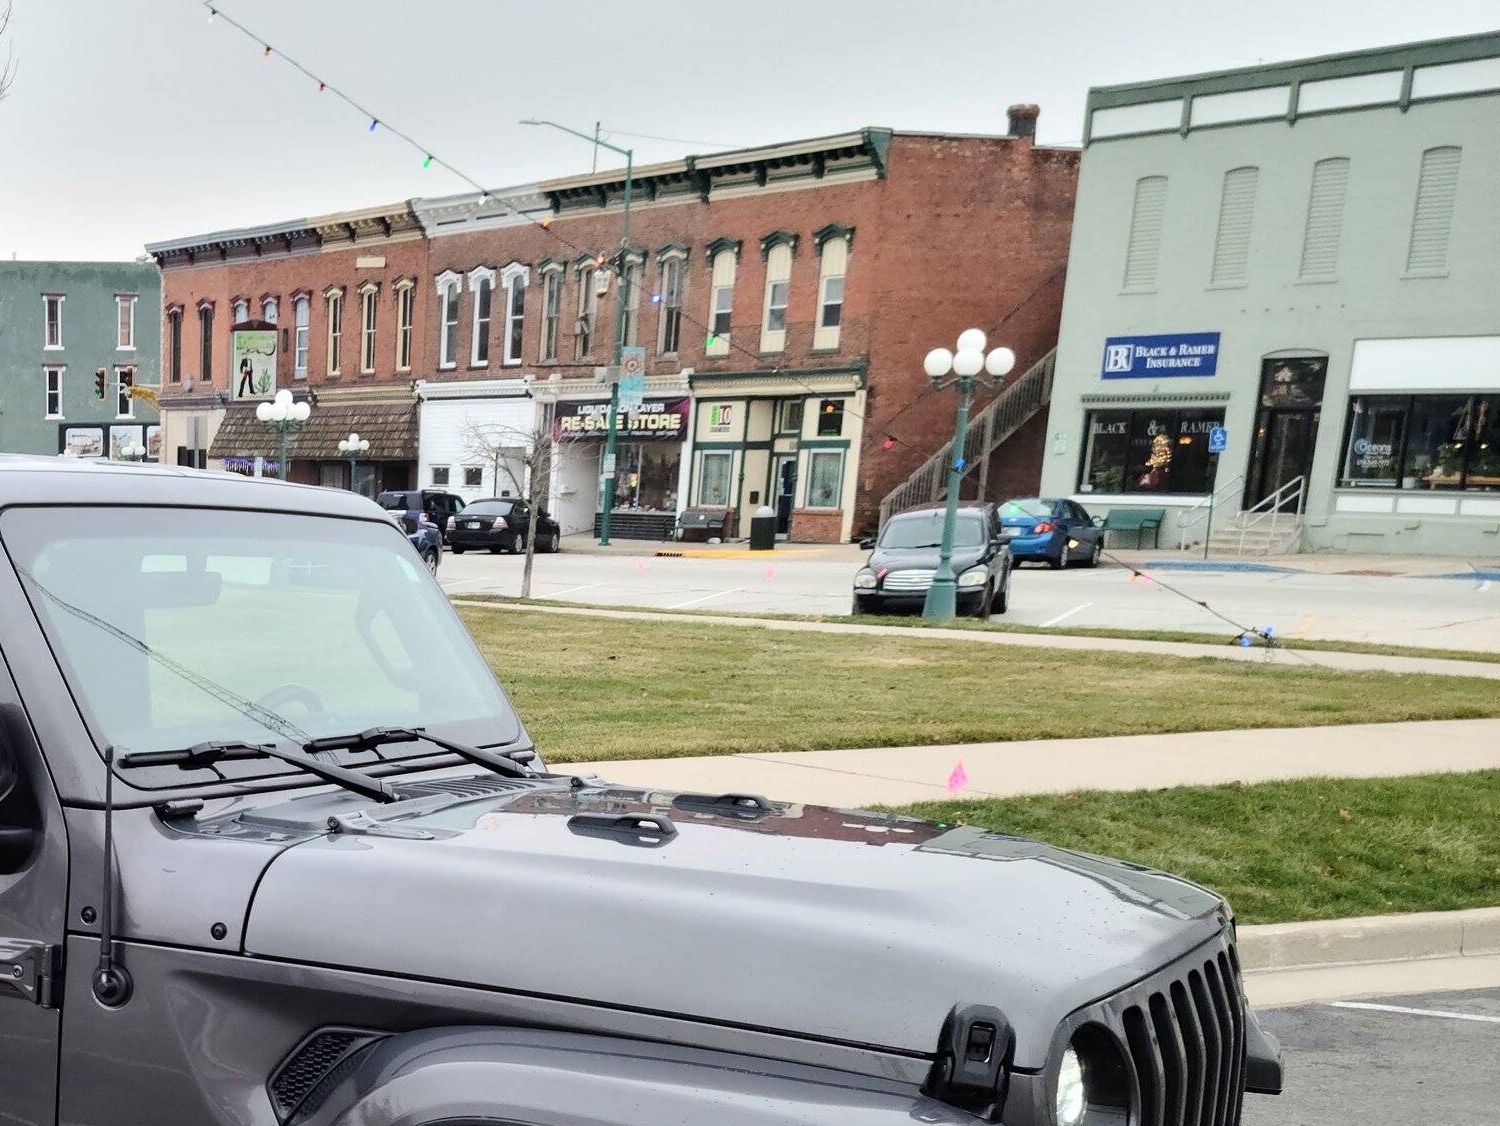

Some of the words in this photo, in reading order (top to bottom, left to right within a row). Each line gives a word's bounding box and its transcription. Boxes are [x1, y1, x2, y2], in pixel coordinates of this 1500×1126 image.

[1135, 346, 1167, 358] BLACK
[1168, 347, 1177, 356] &
[1178, 343, 1215, 355] RAMER
[1146, 357, 1202, 369] INSURANCE
